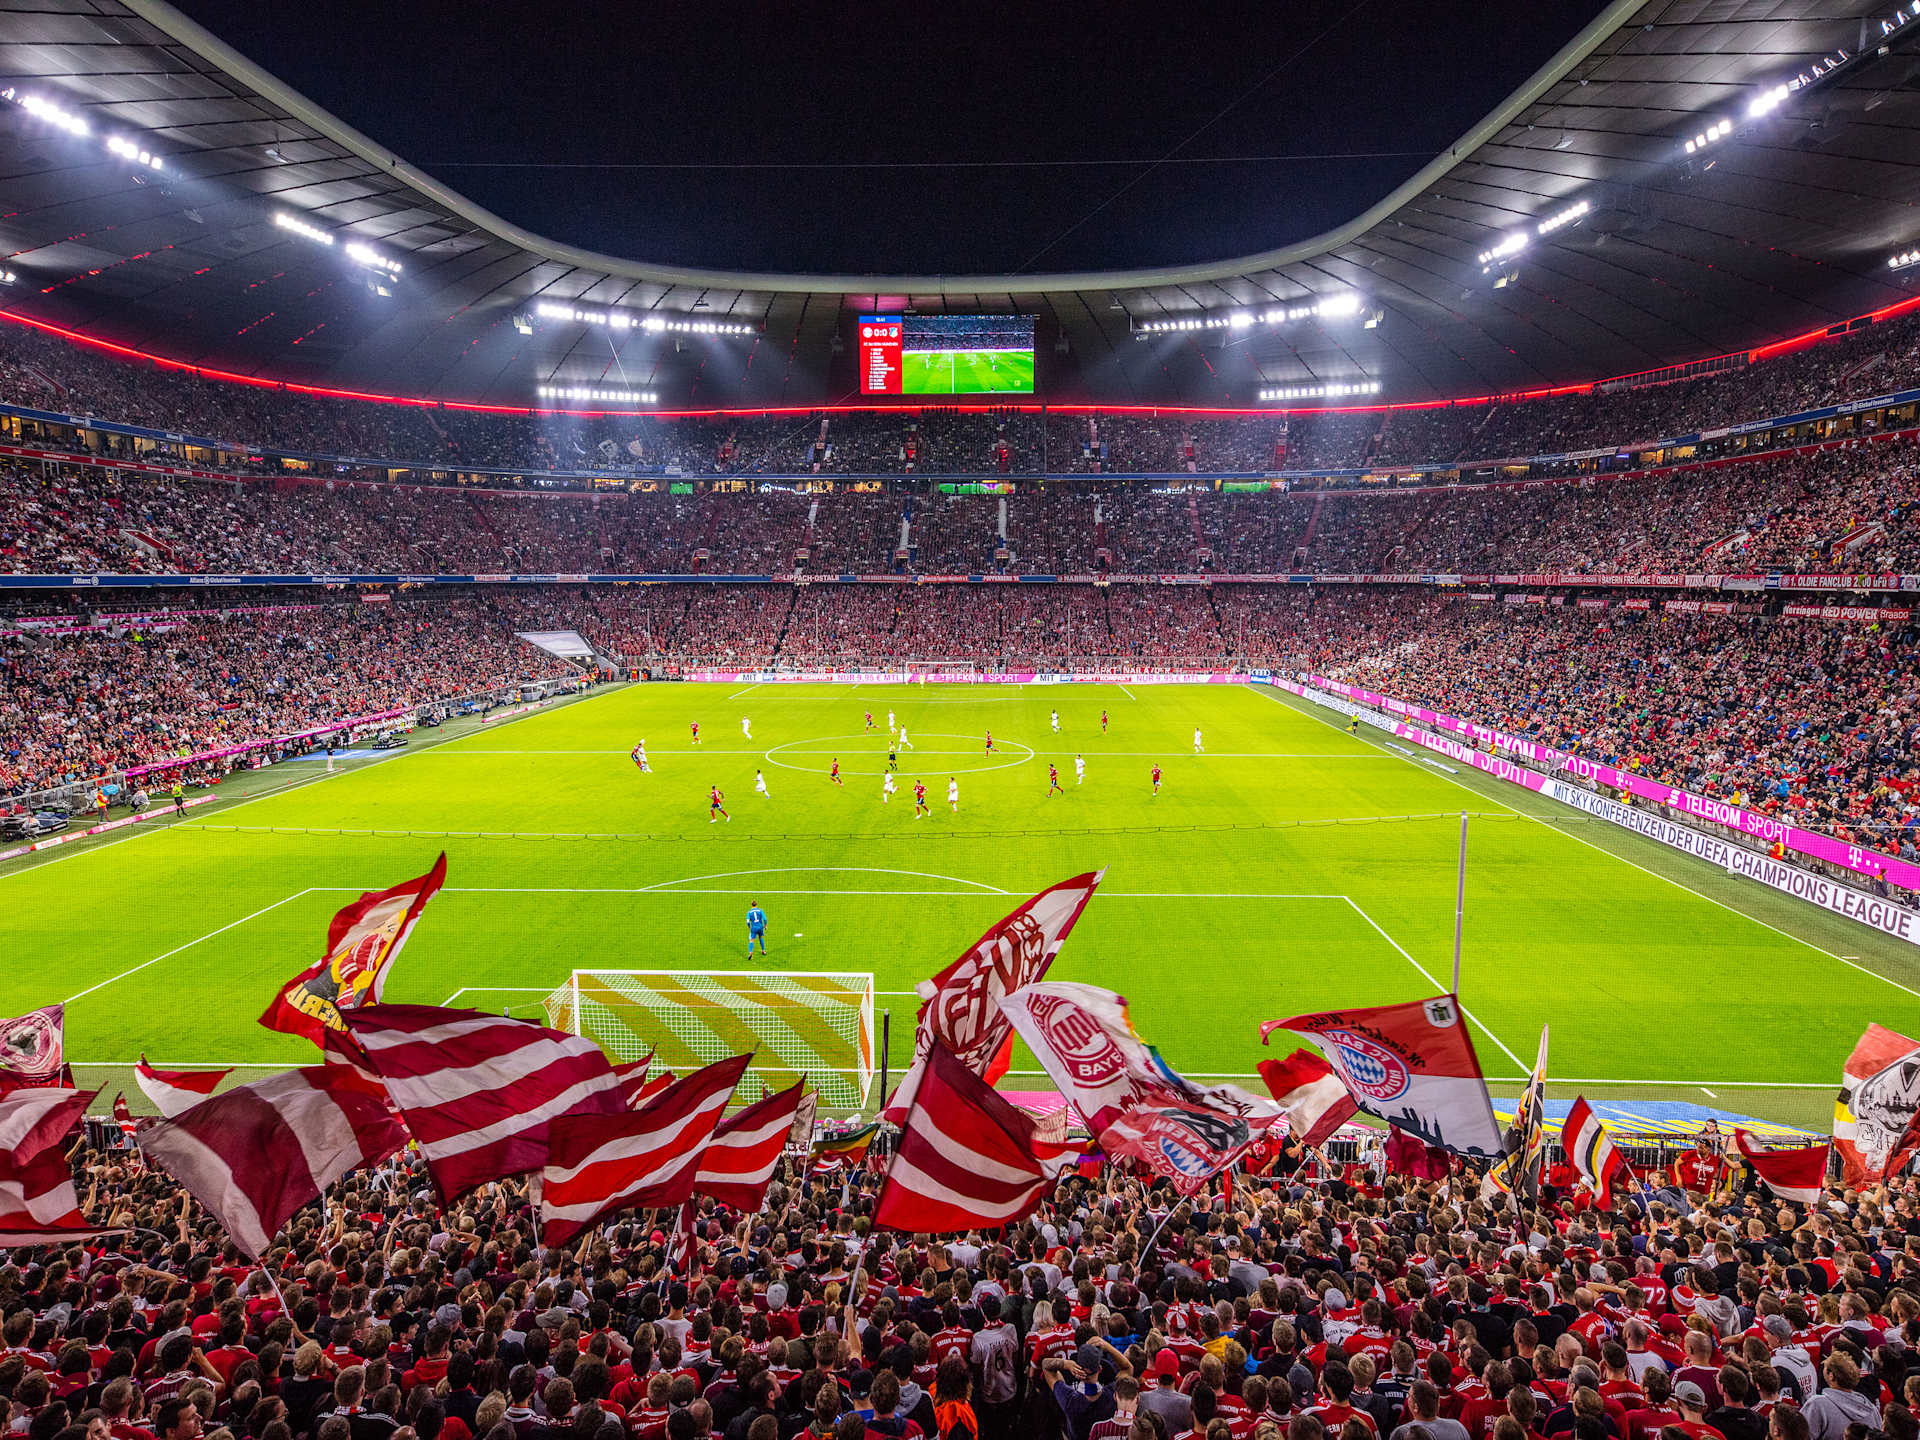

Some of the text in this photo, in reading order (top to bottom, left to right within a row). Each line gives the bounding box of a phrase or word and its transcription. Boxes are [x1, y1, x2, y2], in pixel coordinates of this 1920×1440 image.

[1798, 577, 1818, 587] OLDIE
[1819, 577, 1852, 587] FANCLUB
[1822, 606, 1879, 619] RED POWER
[988, 674, 1018, 682] SPORT
[1472, 730, 1536, 760] TELEKOM
[1685, 792, 1741, 827] TELEKOM
[1747, 814, 1792, 843] SPORT
[1553, 783, 1912, 938] MIT SKY KONFERENZEN DER UEFA CHAMPIONS LEAGUE
[753, 911, 759, 923] 1
[1643, 1288, 1667, 1305] 72
[994, 1350, 1005, 1371] 6
